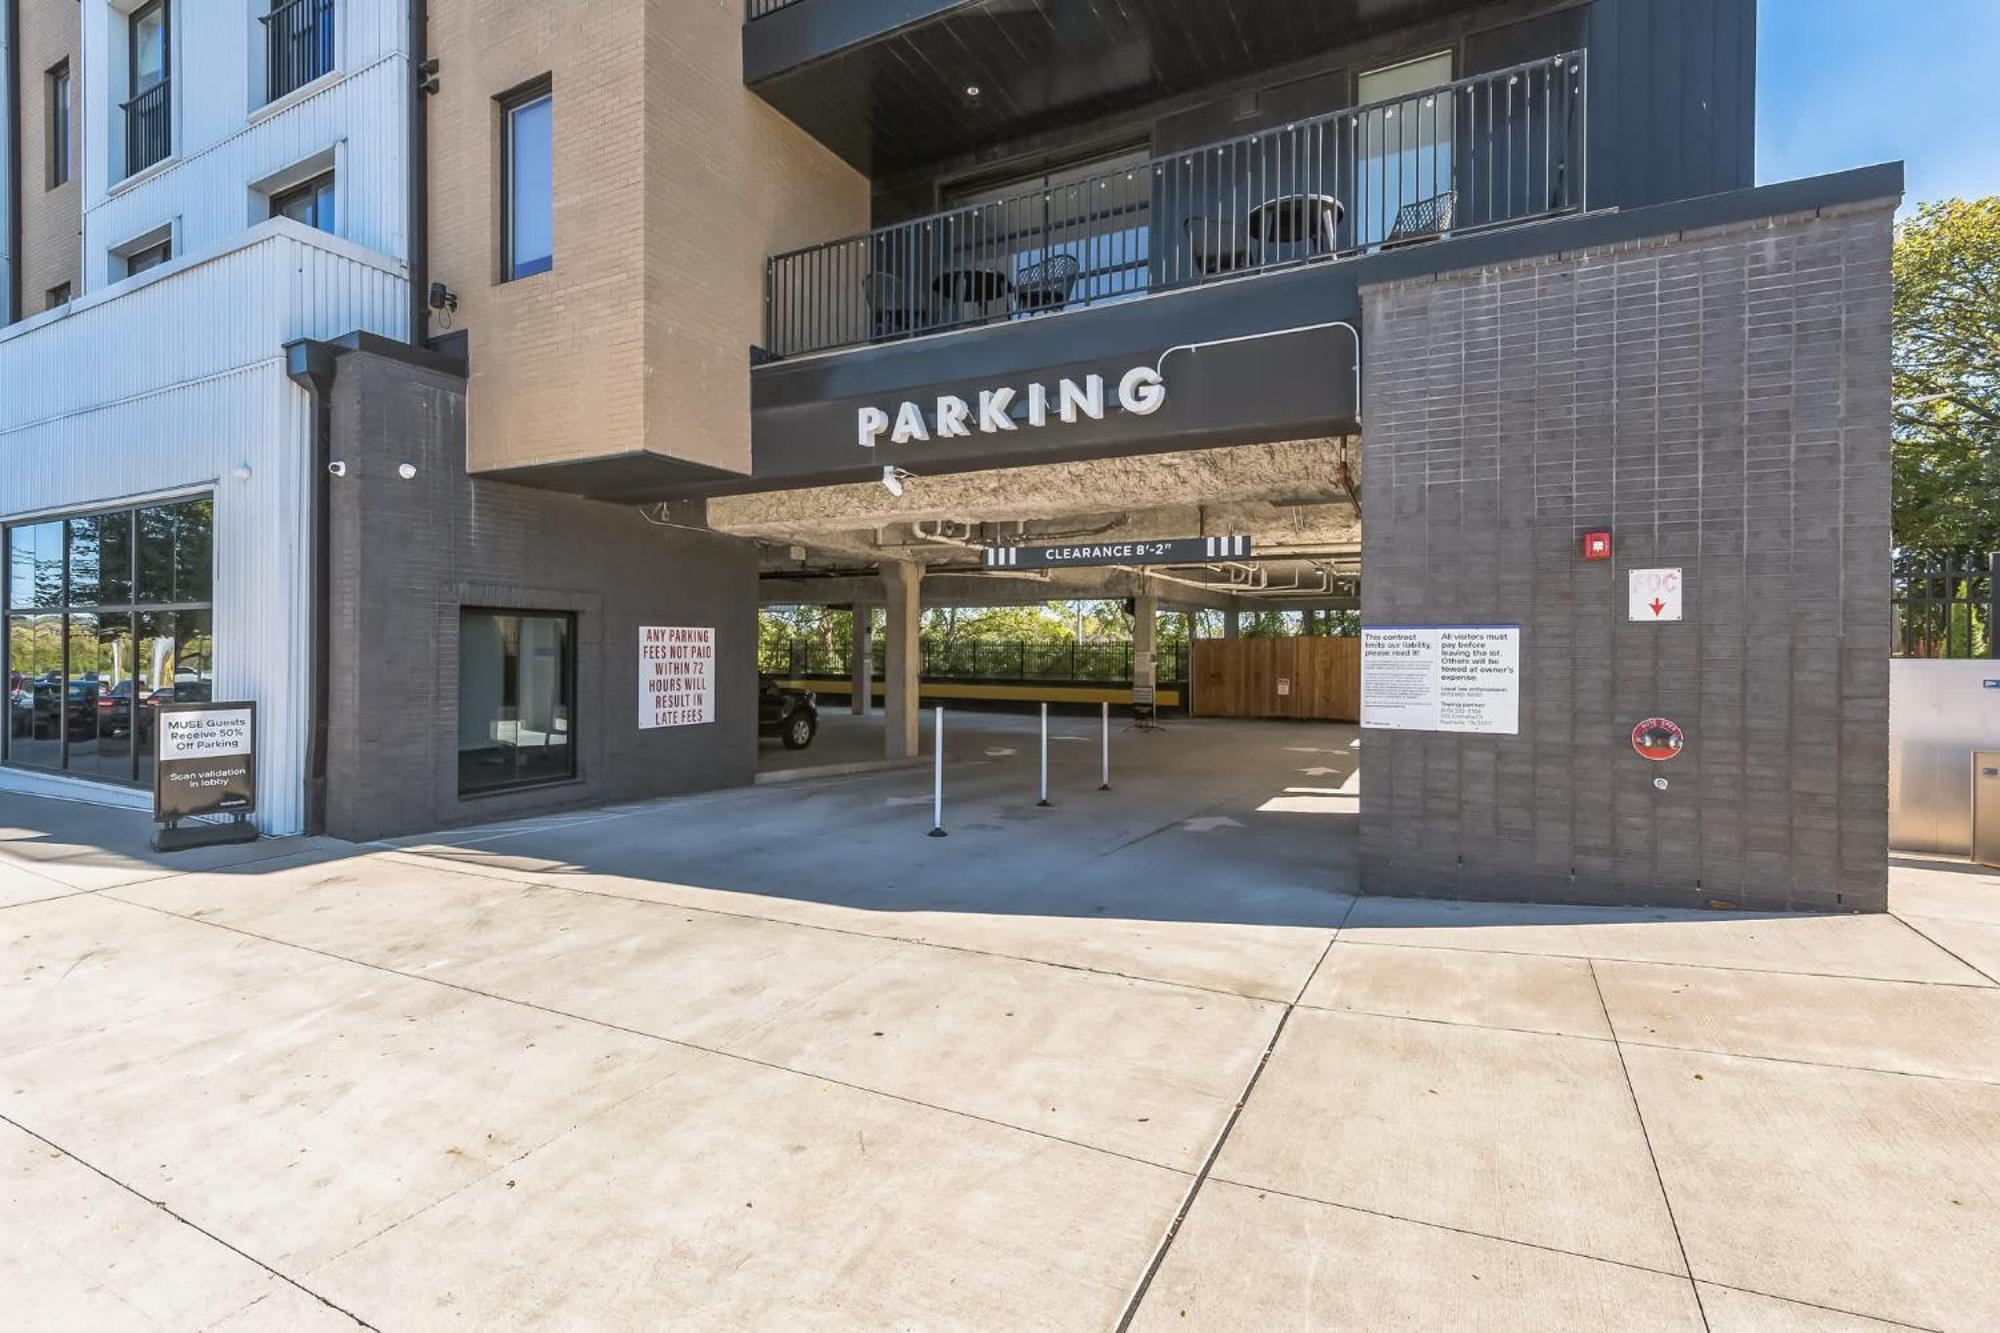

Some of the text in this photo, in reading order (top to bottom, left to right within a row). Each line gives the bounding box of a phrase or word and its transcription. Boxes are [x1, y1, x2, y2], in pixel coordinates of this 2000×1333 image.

[858, 366, 1165, 447] PARKING
[1045, 544, 1132, 560] CLEARANCE
[646, 629, 709, 643] ANY PARKING
[643, 645, 712, 659] FEES NOT PAID
[655, 662, 704, 675] WITHIN 72
[649, 678, 707, 692] HOURS WILL
[655, 694, 703, 709] RESULT IN
[168, 718, 246, 730] MUSE Guests
[655, 709, 703, 726] LATE FEES
[171, 728, 244, 740] Receive 50%
[176, 739, 239, 751] Off Parking
[170, 767, 247, 781] Scan validation
[189, 777, 229, 788] in lobby
